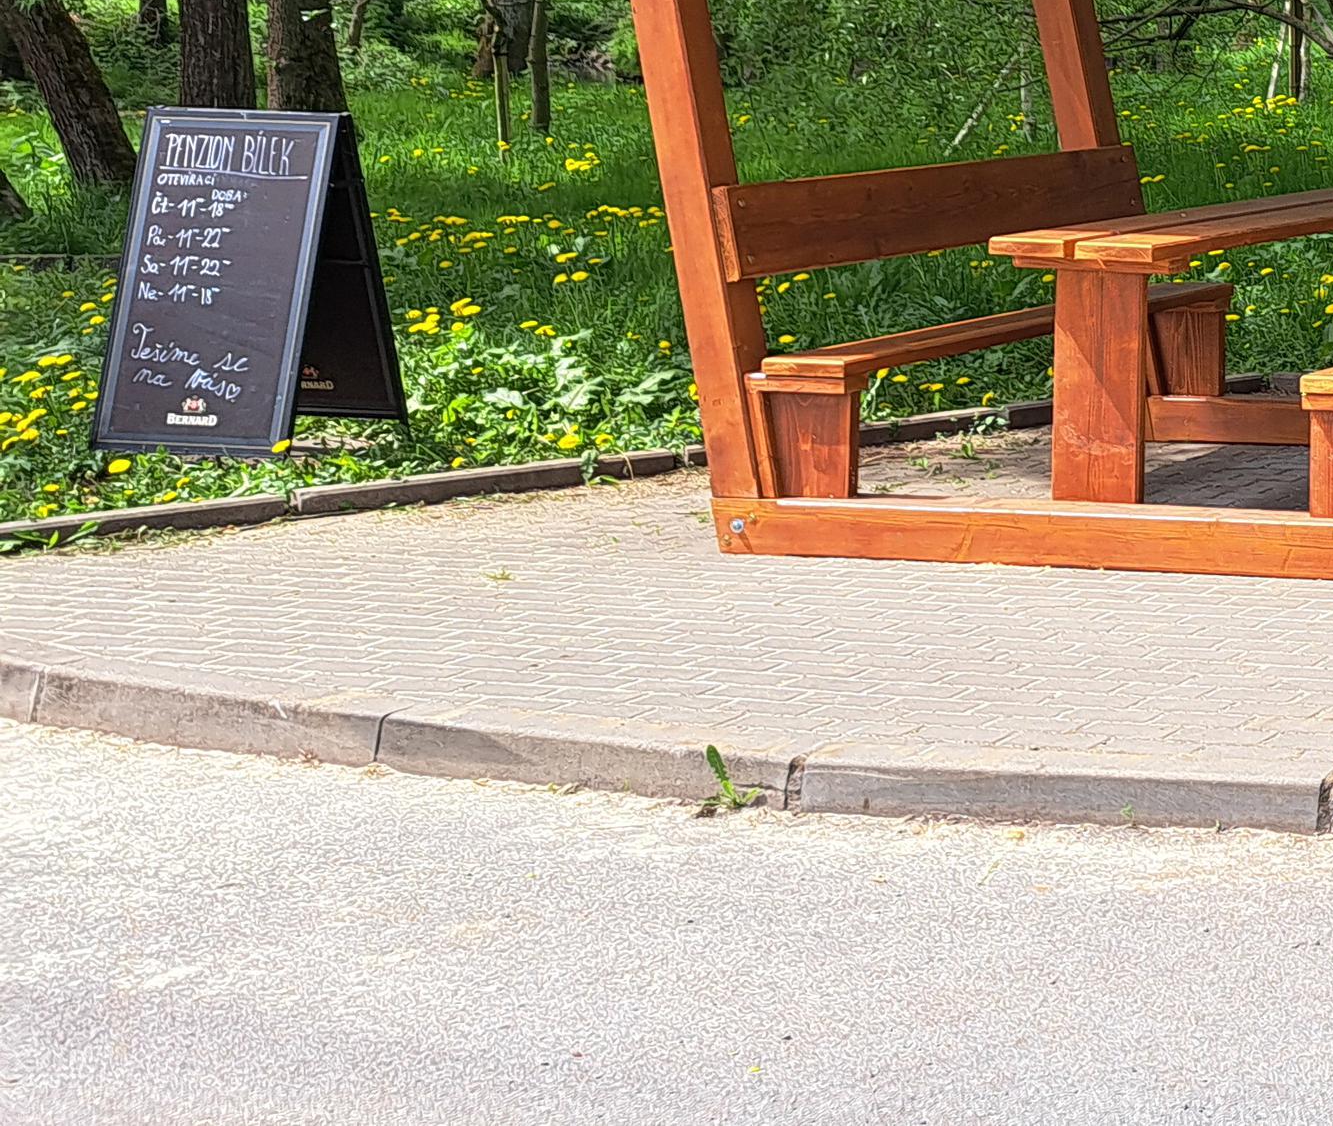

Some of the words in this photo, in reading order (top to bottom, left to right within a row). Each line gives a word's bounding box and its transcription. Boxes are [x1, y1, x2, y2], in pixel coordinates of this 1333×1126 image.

[165, 133, 235, 172] PENZION
[241, 130, 295, 176] BÍLEK
[213, 352, 249, 372] se
[132, 368, 173, 387] na
[166, 413, 218, 427] BERNARD
